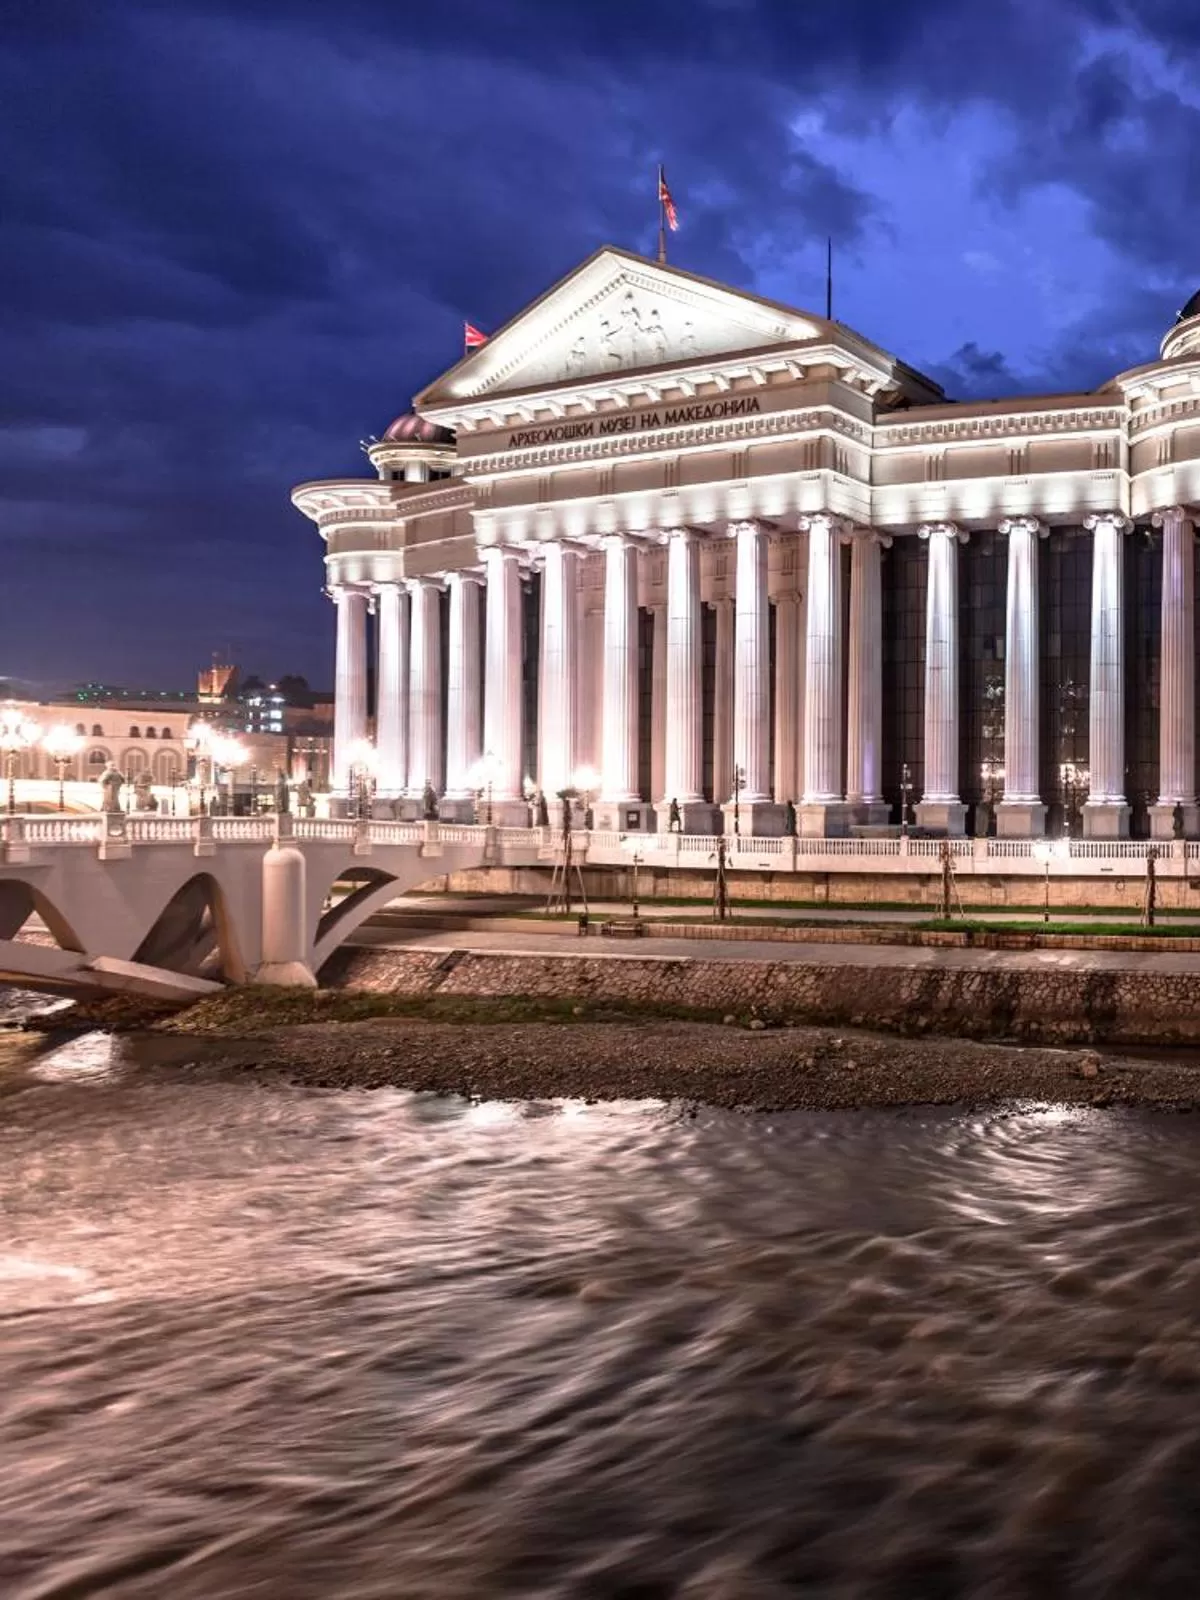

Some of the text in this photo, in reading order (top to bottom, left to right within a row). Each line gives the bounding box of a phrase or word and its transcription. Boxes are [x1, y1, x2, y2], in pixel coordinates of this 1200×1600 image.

[508, 396, 760, 448] АРХЕОЛОШКИ МУЗЕЈ НА МАКЕДОНИЈА
